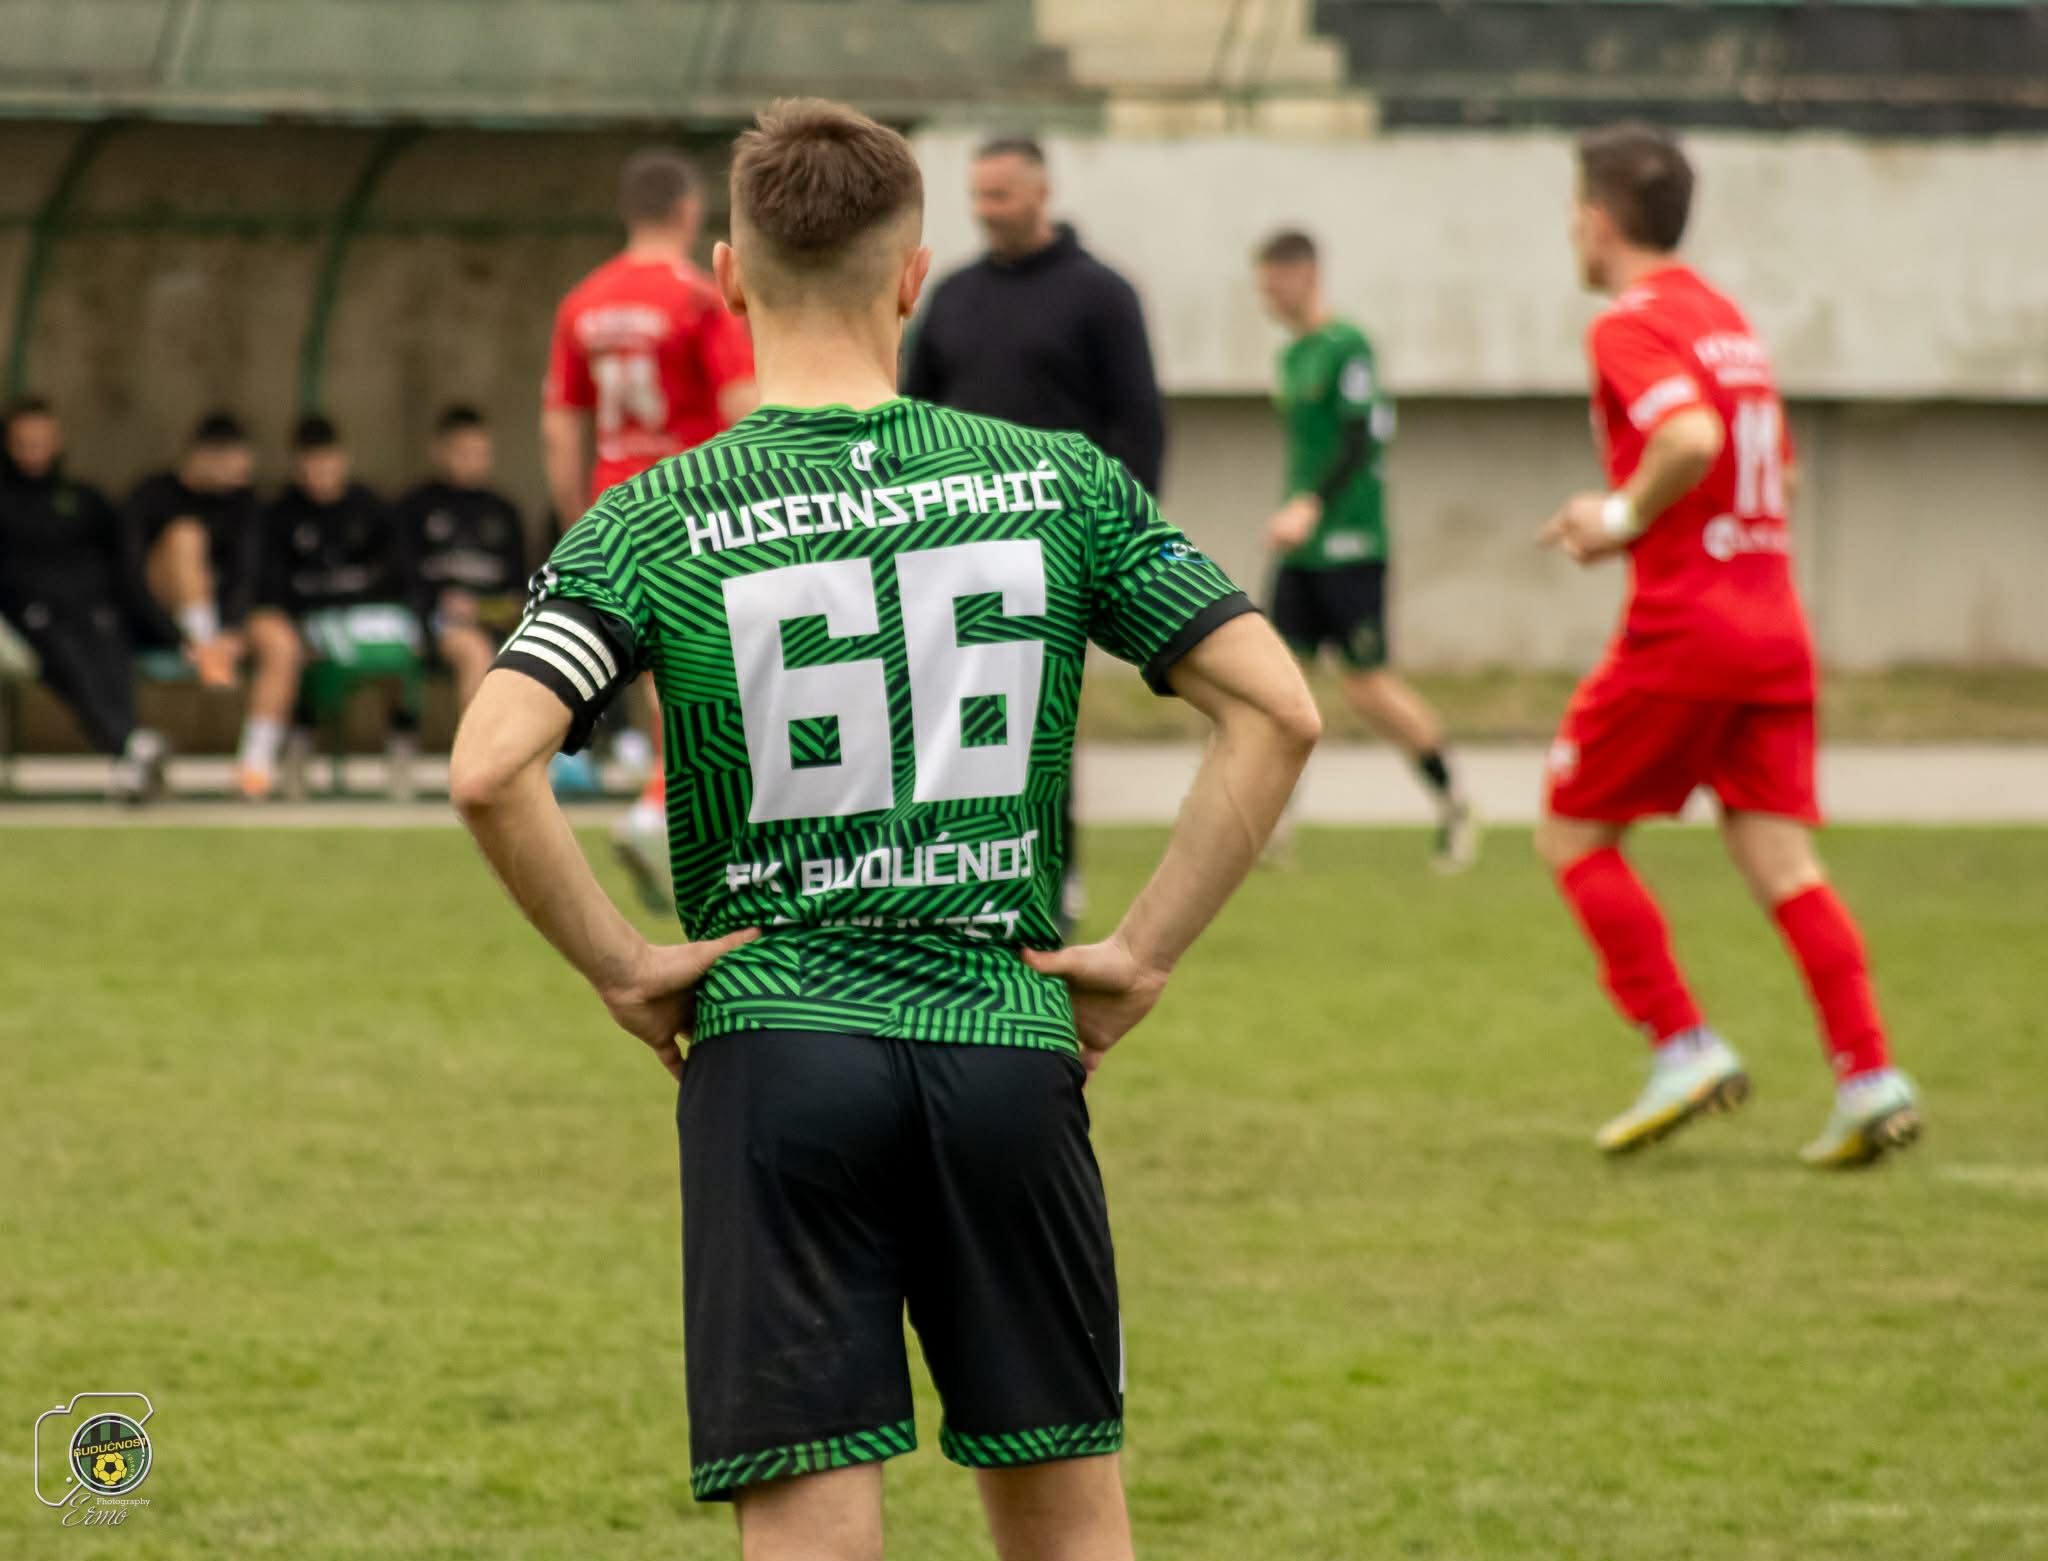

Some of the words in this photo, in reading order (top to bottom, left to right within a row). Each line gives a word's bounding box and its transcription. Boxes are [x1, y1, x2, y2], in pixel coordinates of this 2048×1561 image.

[685, 460, 1063, 555] HUSEINSPAHIĆ
[721, 539, 1046, 823] 66
[726, 861, 782, 893] FK
